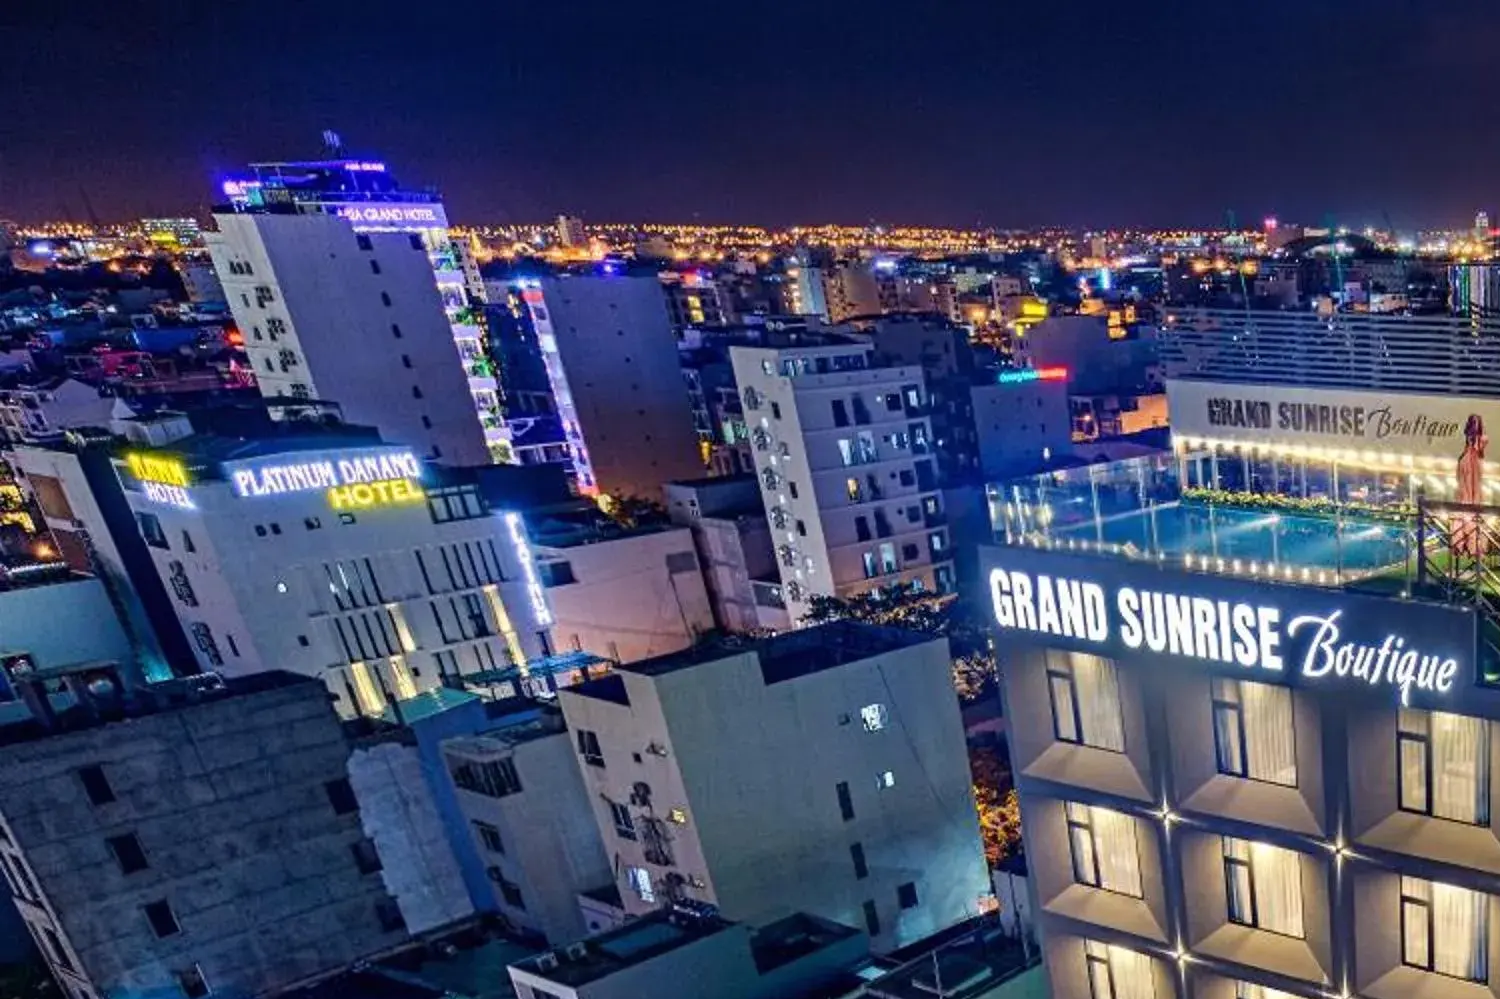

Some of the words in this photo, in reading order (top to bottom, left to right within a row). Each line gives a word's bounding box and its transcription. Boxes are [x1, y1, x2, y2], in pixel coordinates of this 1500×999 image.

[1207, 397, 1272, 429] GRAND
[1278, 401, 1365, 436] SUNRISE
[1368, 400, 1460, 444] Boutique
[233, 461, 337, 496] PLATINUM
[338, 452, 420, 483] DANANG
[330, 478, 423, 508] HOTEL
[988, 567, 1108, 641] GRAND
[1117, 586, 1284, 671] SUNRISE
[1287, 608, 1458, 707] Boutique
